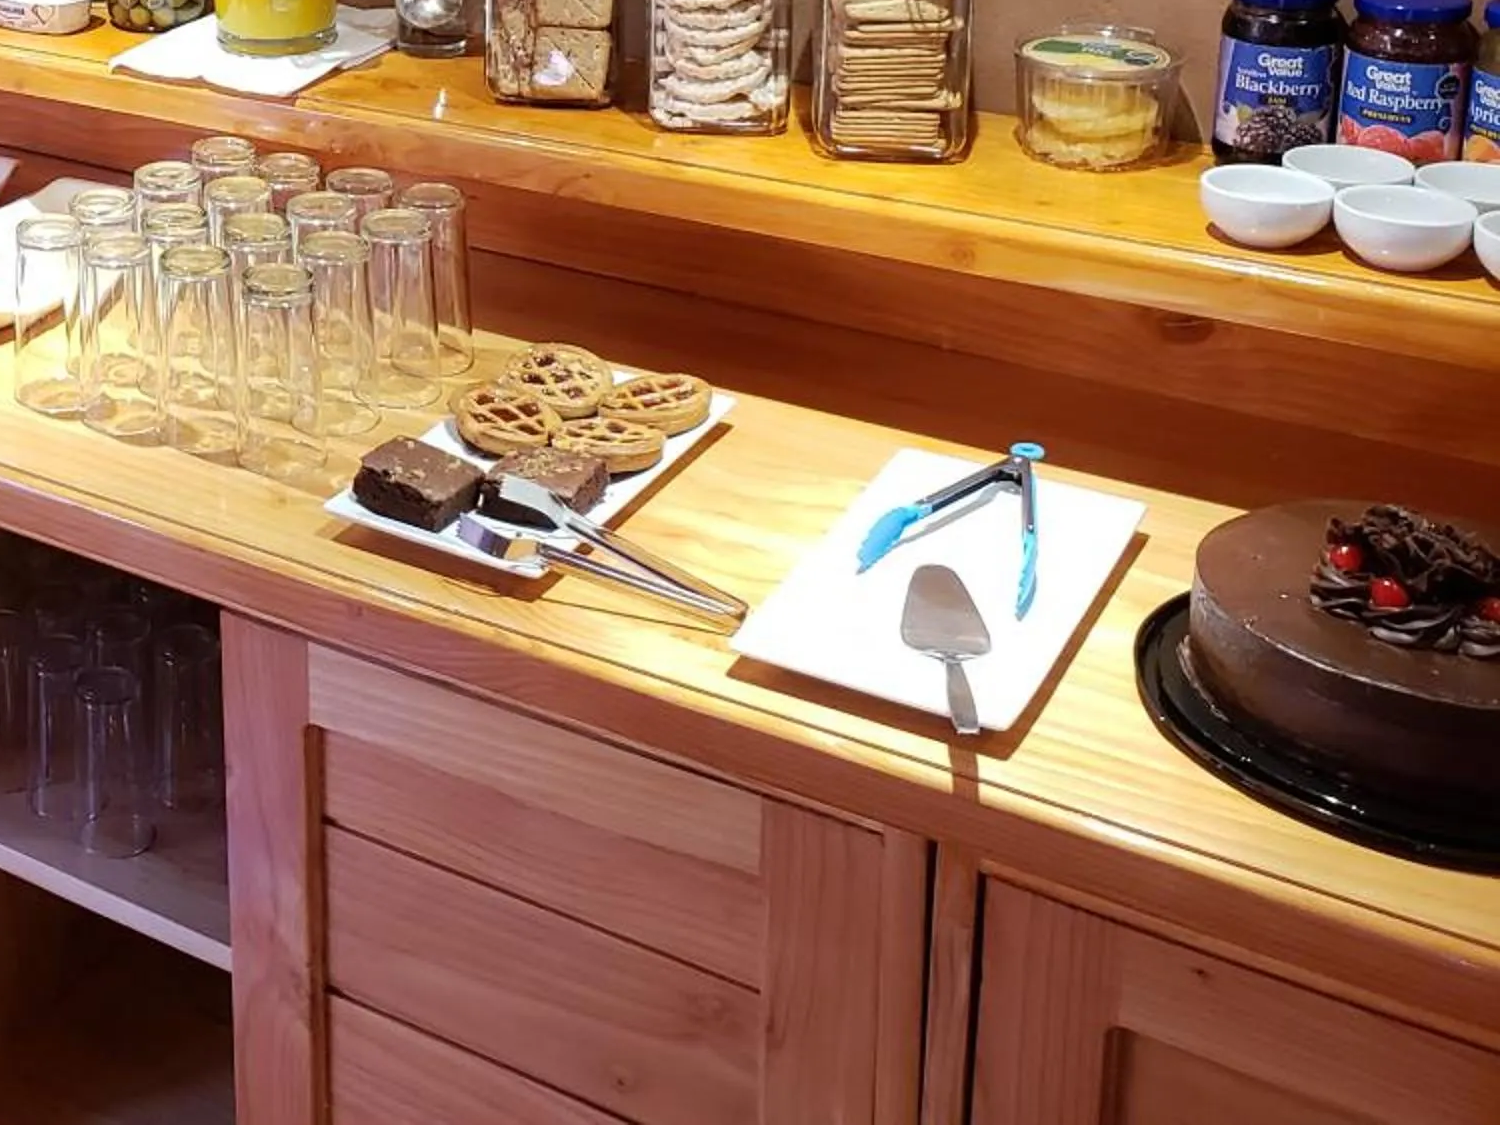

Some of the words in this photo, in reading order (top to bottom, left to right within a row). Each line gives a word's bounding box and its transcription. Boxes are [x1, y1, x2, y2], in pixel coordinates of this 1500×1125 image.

[1257, 52, 1304, 70] Great
[1267, 66, 1304, 78] Value
[1365, 65, 1412, 84] Great
[1235, 73, 1321, 100] Blackberry
[1375, 78, 1411, 93] Value
[1368, 88, 1443, 114] Raspberry
